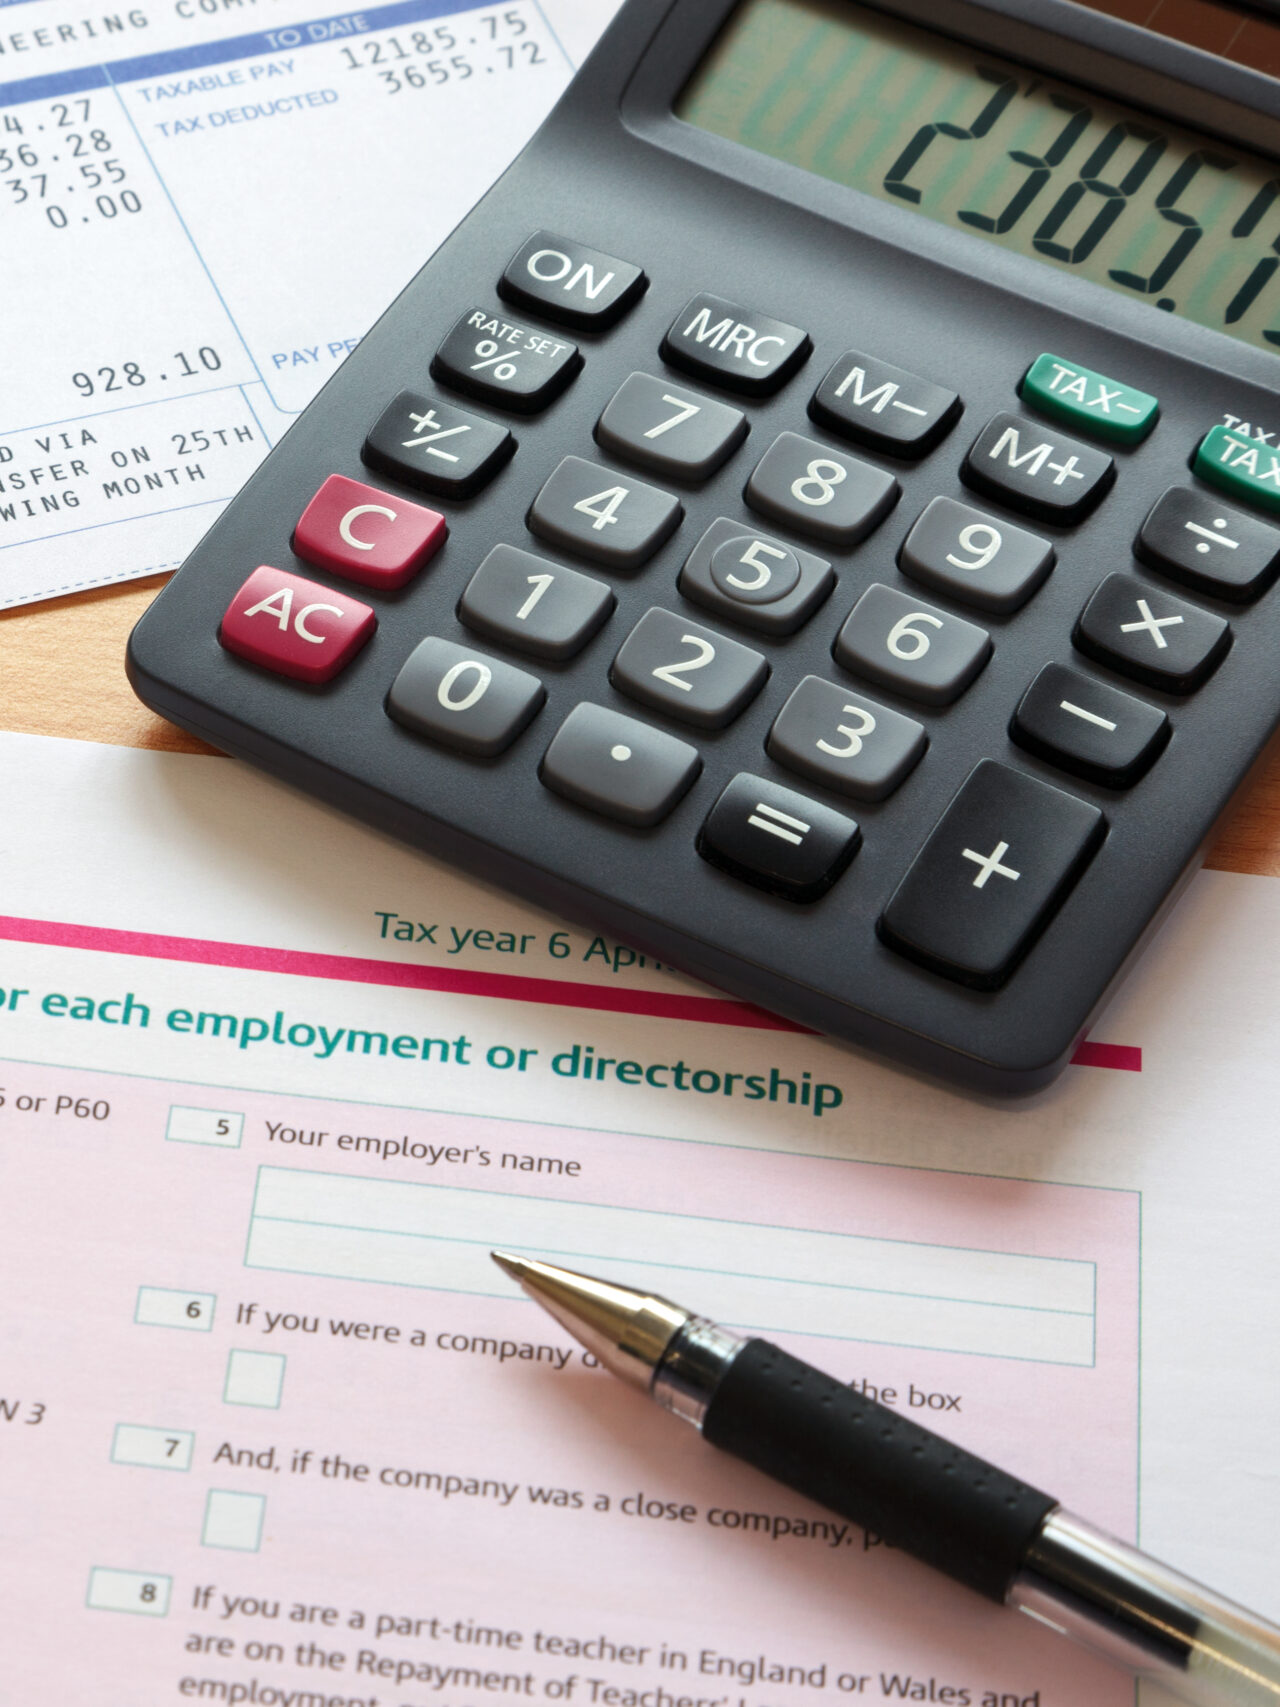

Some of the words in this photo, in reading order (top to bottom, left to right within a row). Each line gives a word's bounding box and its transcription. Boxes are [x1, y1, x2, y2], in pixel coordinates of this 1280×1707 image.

[264, 27, 301, 50] TO
[309, 13, 370, 42] DATE
[137, 70, 230, 104] TAXABLE
[234, 58, 296, 85] PAY
[340, 10, 529, 71] 12185.75
[155, 113, 202, 138] TAX
[207, 87, 340, 131] DEDUCTED
[381, 42, 546, 95] 3655.72
[8, 158, 126, 204] 37.55
[46, 189, 142, 229] 0.00
[527, 247, 614, 301] ON
[272, 346, 319, 369] PAY
[468, 310, 523, 344] RATE
[528, 332, 567, 361] SET
[682, 305, 787, 368] MRC
[72, 345, 221, 397] 928.10
[36, 428, 98, 454] VIA
[644, 394, 702, 439] 7
[111, 449, 149, 472] ON
[172, 423, 255, 456] 25TH
[988, 426, 1085, 487] M+
[103, 461, 206, 499] MONTH
[790, 458, 848, 506] 8
[339, 504, 397, 551] C
[572, 486, 630, 531] 4
[725, 540, 787, 592] 5
[945, 523, 1003, 571] 9
[243, 587, 344, 644] AC
[517, 573, 554, 620] 1
[886, 611, 944, 661] 6
[436, 660, 493, 712] 0
[652, 634, 716, 691] 2
[815, 704, 877, 758] 3
[373, 911, 438, 945] Tax
[446, 924, 535, 955] year
[549, 932, 571, 959] 6
[41, 993, 150, 1028] each
[166, 1005, 471, 1064] employment
[487, 1045, 538, 1072] or
[551, 1045, 843, 1116] directorship
[54, 1096, 111, 1121] P60
[264, 1120, 329, 1149] Your
[337, 1131, 492, 1169] employer's
[500, 1150, 582, 1178] name
[329, 1319, 401, 1343] were
[436, 1331, 573, 1369] company
[908, 1384, 962, 1412] box
[213, 1442, 280, 1472] And,
[379, 1465, 519, 1506] company
[620, 1493, 697, 1524] close
[707, 1507, 854, 1547] company,
[355, 1650, 535, 1696] Repayment
[374, 1613, 523, 1650] part-time
[533, 1630, 649, 1668] teacher
[699, 1650, 828, 1690] England
[880, 1673, 973, 1706] Wales
